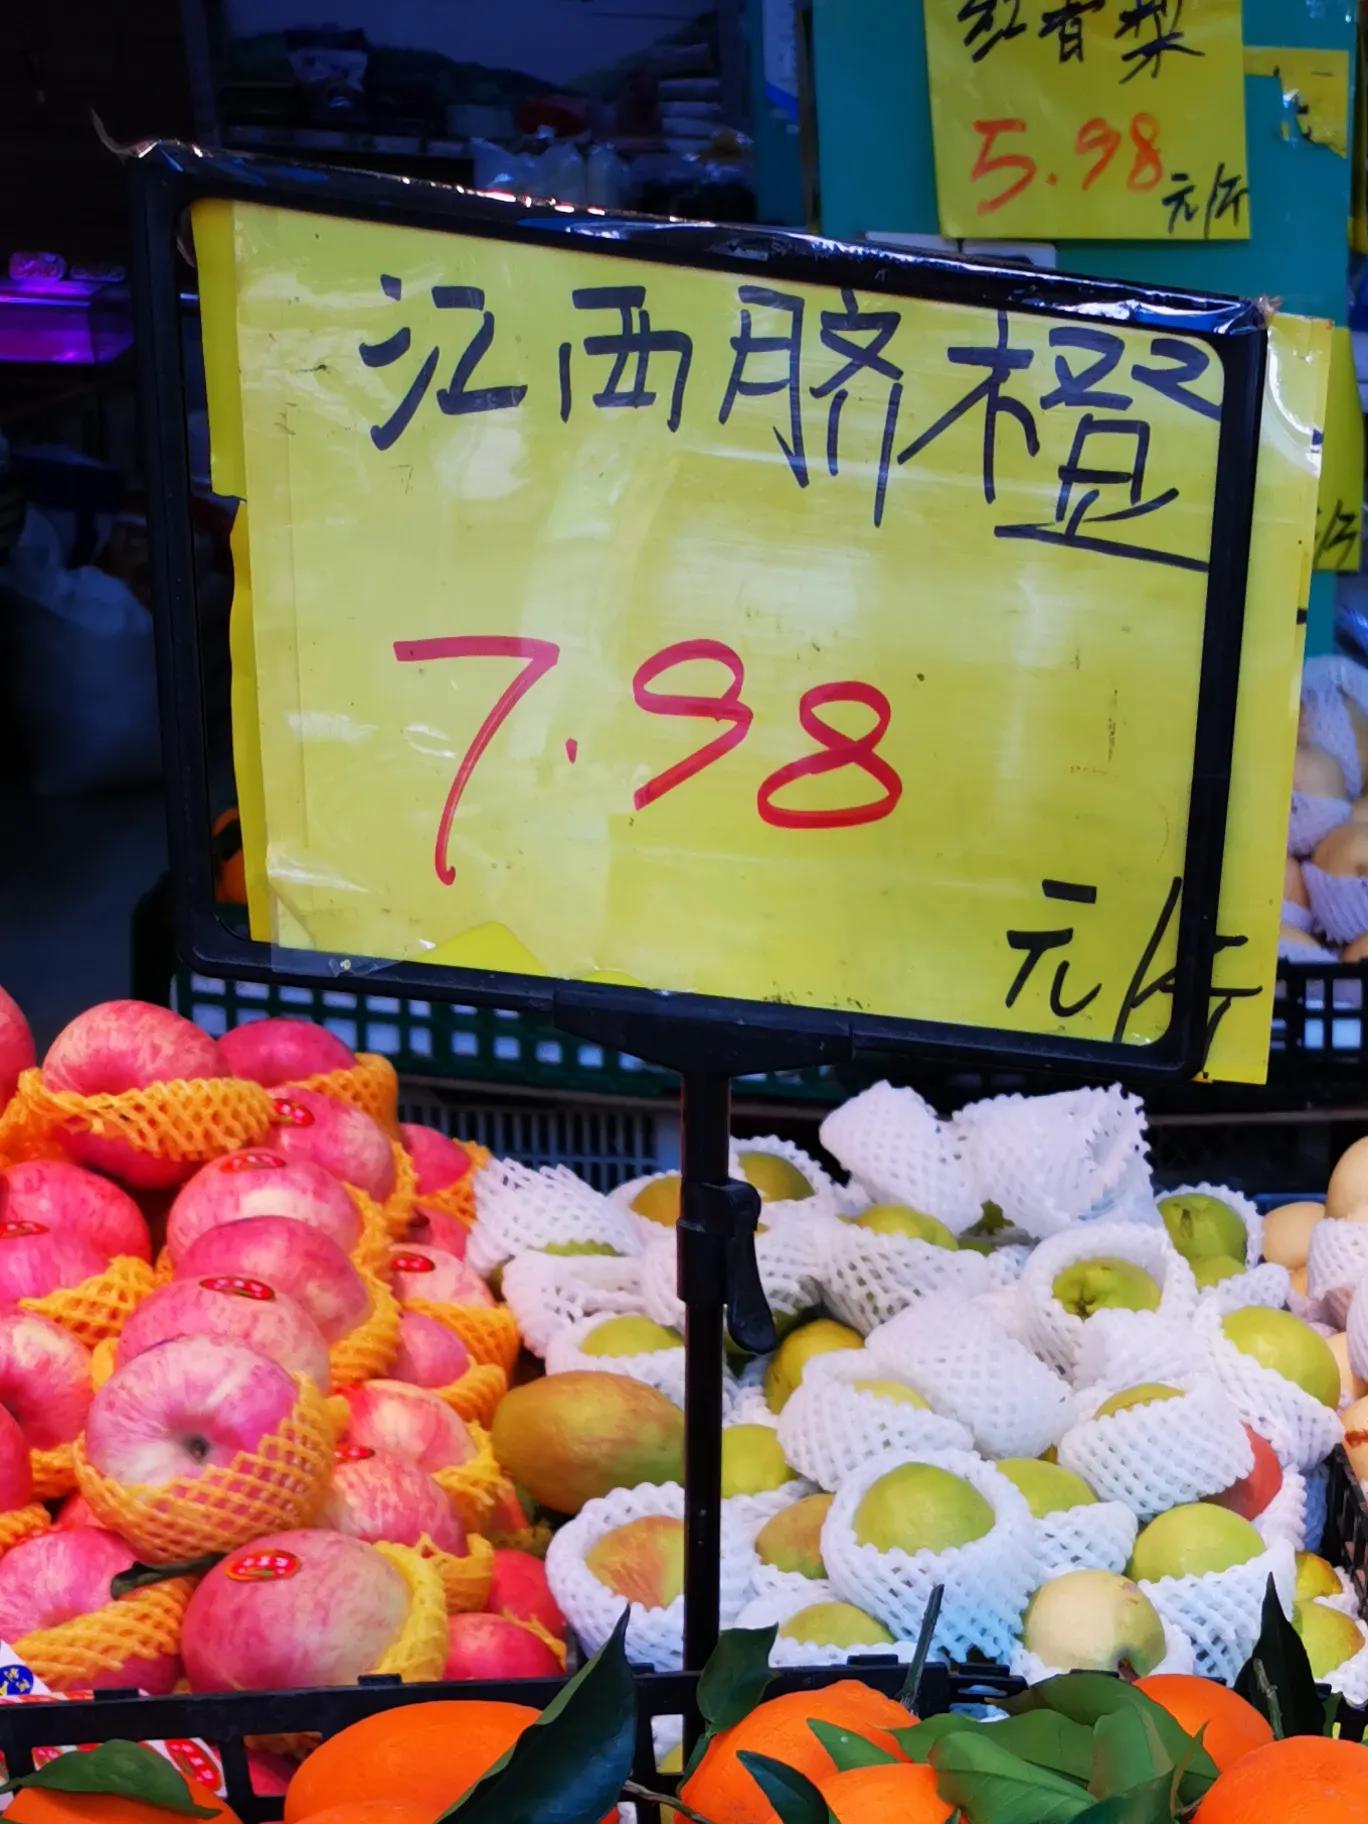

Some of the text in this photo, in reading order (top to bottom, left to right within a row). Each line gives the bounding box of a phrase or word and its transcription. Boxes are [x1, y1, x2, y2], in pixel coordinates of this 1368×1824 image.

[971, 112, 1164, 216] 5.98
[360, 274, 1221, 572] 江西脐橙
[393, 635, 903, 886] 7.98
